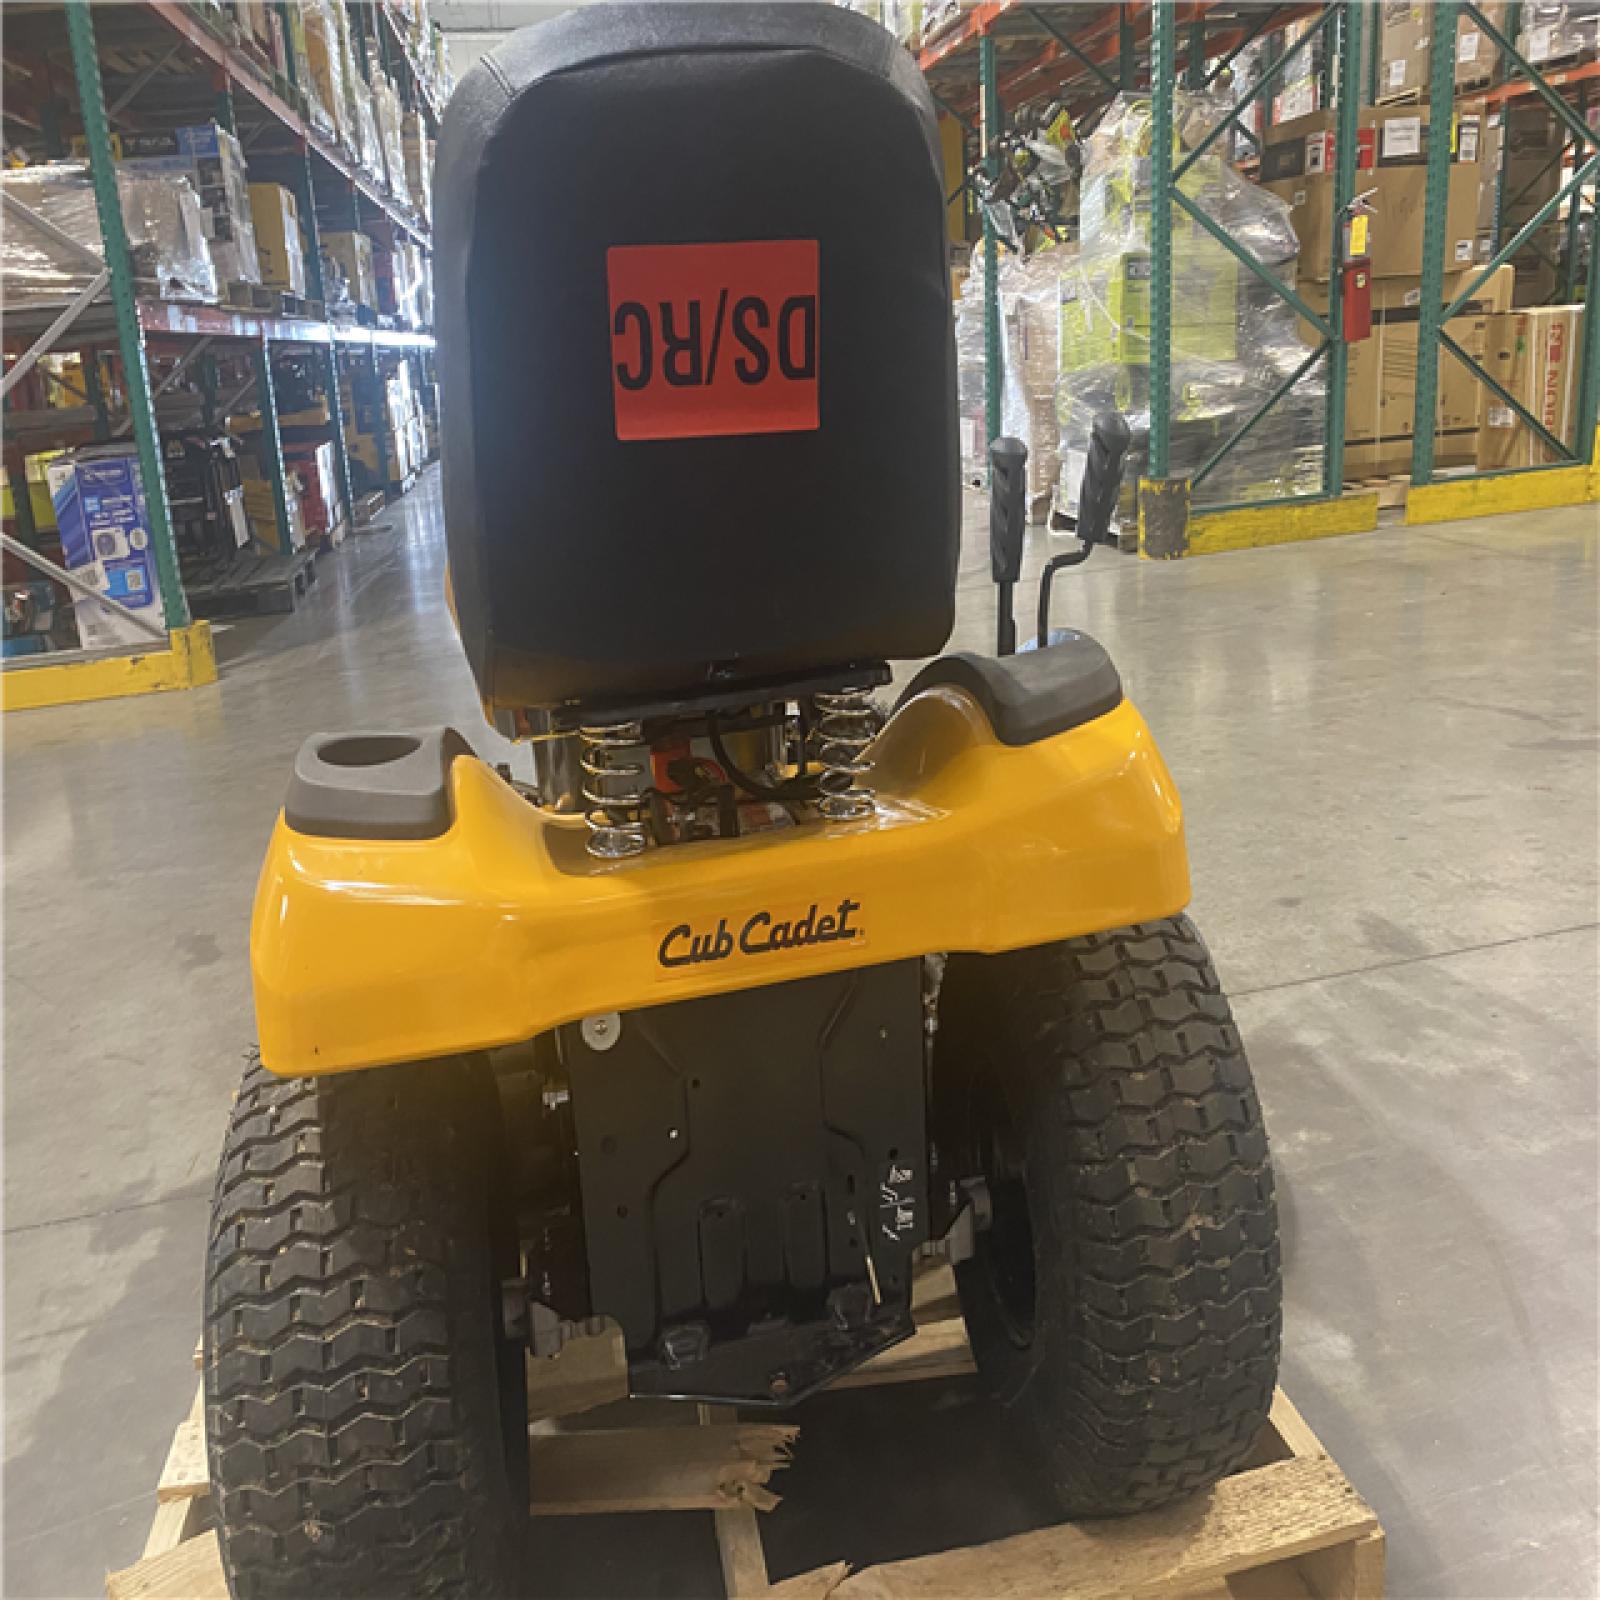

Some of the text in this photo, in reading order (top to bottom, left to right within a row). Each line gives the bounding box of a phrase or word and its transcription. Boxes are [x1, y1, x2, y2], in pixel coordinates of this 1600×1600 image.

[614, 287, 816, 391] DS/RC
[657, 898, 861, 968] Cub Cadet
